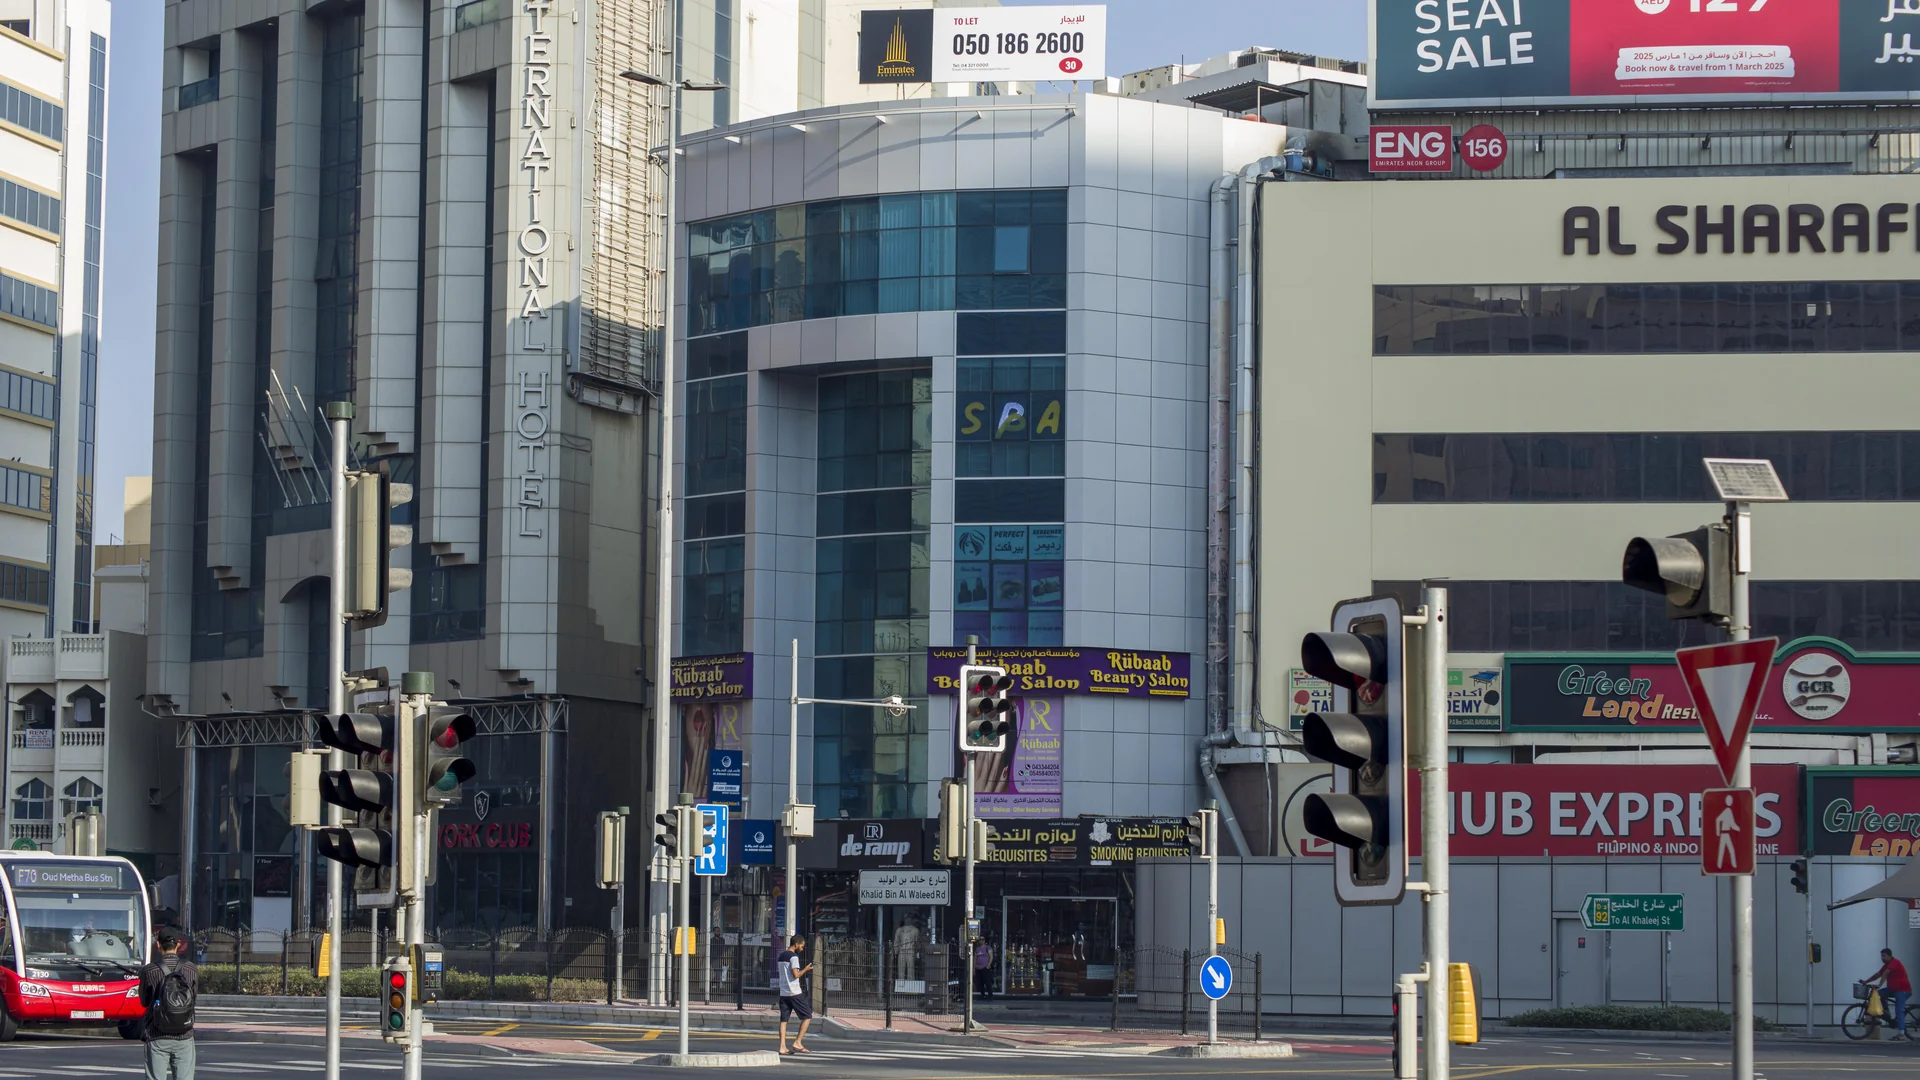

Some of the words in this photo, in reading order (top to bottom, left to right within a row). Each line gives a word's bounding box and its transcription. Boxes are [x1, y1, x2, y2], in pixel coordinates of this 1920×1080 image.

[965, 17, 979, 25] LET
[953, 33, 989, 55] 050
[996, 32, 1028, 54] 186
[1035, 32, 1084, 54] 2600
[1416, 32, 1534, 73] SALE
[1656, 52, 1680, 61] مارس
[1689, 53, 1702, 61] من
[877, 65, 915, 74] Emirates
[1065, 61, 1076, 70] 30
[1678, 64, 1703, 72] travel
[1705, 63, 1726, 71] from
[1735, 62, 1762, 71] March
[1375, 132, 1446, 158] ENG
[1465, 138, 1503, 158] 156
[520, 0, 551, 350] TERNATIONAL
[1563, 206, 1637, 255] AL
[1656, 203, 1920, 255] SHARAF
[960, 400, 1061, 439] SPA
[517, 371, 548, 538] HOTEL
[994, 530, 1025, 538] PERFECT
[1107, 652, 1171, 671] Rübaab
[672, 666, 724, 686] Rübaab
[1020, 676, 1080, 690] Salon
[1089, 669, 1146, 687] Beauty
[1149, 673, 1188, 688] Salon
[1558, 664, 1652, 700] Green
[670, 684, 705, 698] eauty
[706, 682, 743, 697] Salon
[1797, 680, 1835, 694] GCR
[1582, 694, 1664, 725] Land
[1020, 738, 1060, 750] Rübaab
[1448, 791, 1534, 836] UB
[486, 822, 531, 848] CLUB
[1035, 829, 1077, 845] لوازم
[1117, 824, 1160, 841] التدخين
[840, 834, 863, 857] de
[864, 841, 911, 864] ramp
[1090, 846, 1134, 861] SMOKING
[1597, 842, 1650, 854] FILIPINO
[1653, 843, 1663, 854] &
[1665, 843, 1698, 854] INDO
[18, 869, 37, 883] F70
[41, 872, 58, 881] Oud
[59, 873, 83, 882] Metha
[84, 874, 99, 882] Bus
[99, 874, 113, 882] Stn
[878, 875, 897, 885] الوليد
[898, 877, 907, 885] بن
[910, 876, 926, 884] خالد
[929, 876, 947, 886] شارع
[861, 889, 883, 899] Khalid
[885, 889, 897, 899] Bin
[899, 889, 907, 899] Al
[909, 889, 935, 899] Waleed
[936, 889, 946, 899] Rd
[1611, 899, 1639, 912] الخليج
[1643, 899, 1666, 911] شارع
[1668, 899, 1682, 914] إلى
[1595, 912, 1608, 922] 92
[1611, 915, 1620, 925] To
[1622, 916, 1630, 924] Al
[1632, 916, 1660, 926] Khaleej
[1661, 916, 1670, 925] St
